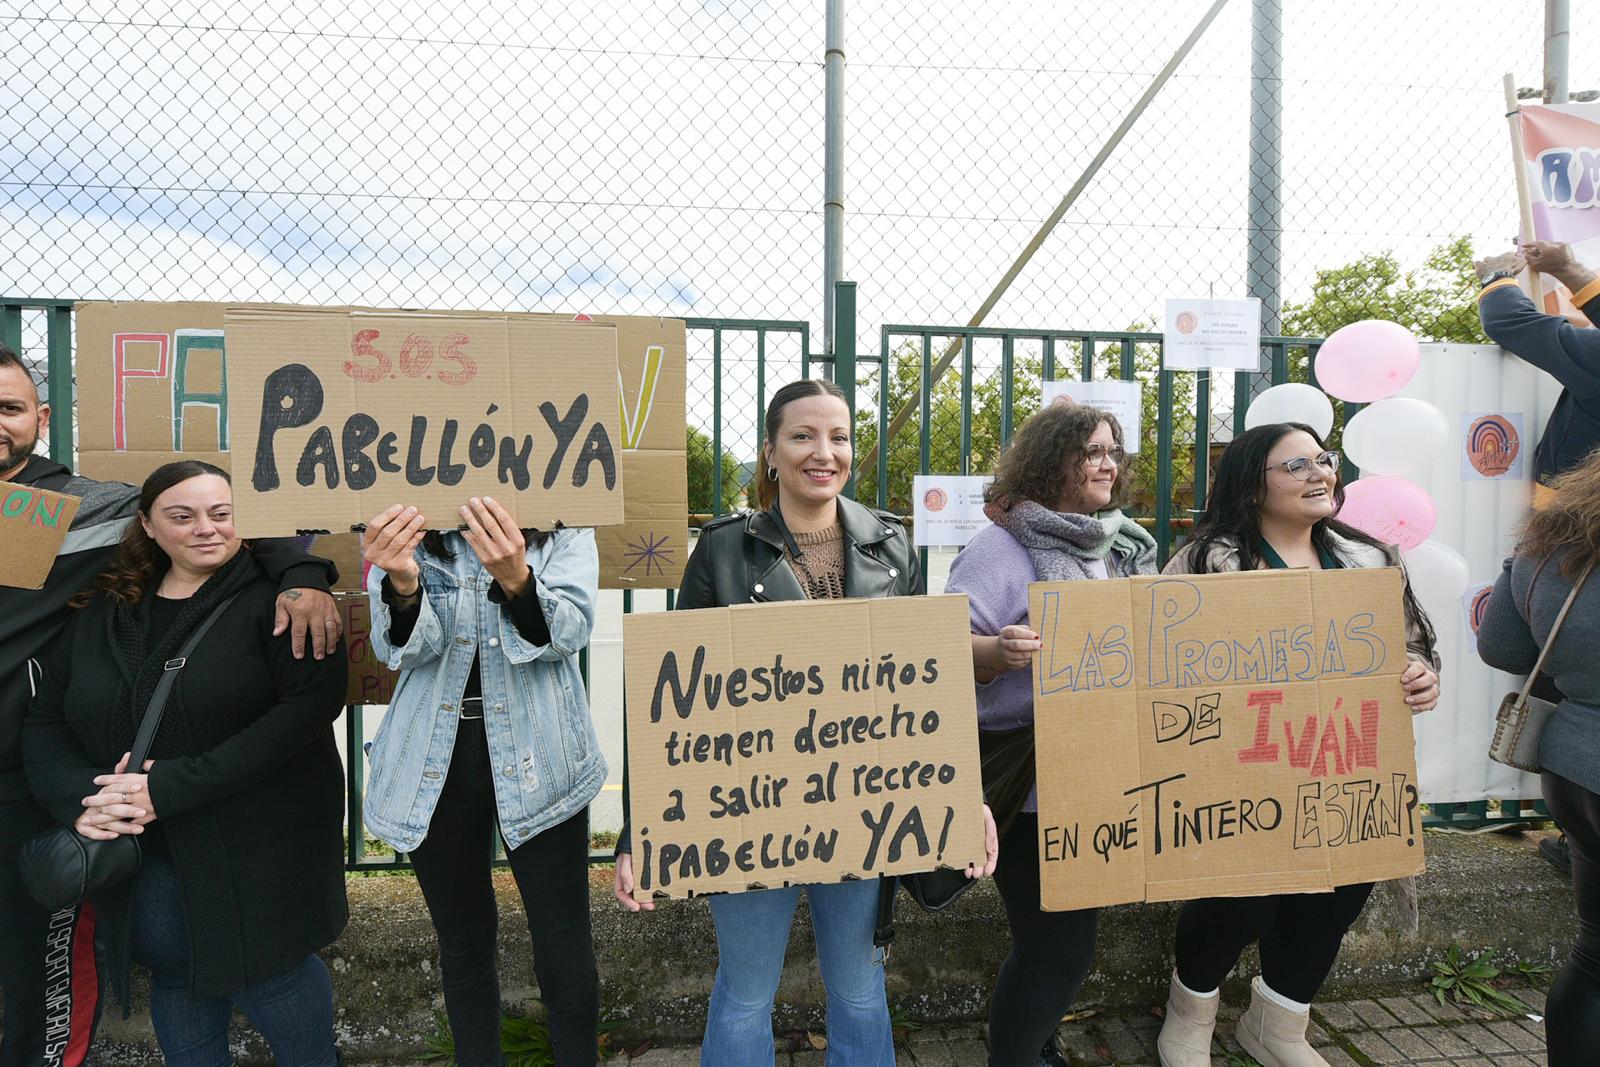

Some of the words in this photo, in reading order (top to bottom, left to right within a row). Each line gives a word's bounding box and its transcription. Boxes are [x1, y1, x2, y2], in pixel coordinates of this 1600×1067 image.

[538, 392, 616, 492] YA
[1040, 591, 1134, 695] LAS
[1146, 579, 1386, 689] PROMESAS
[650, 645, 825, 723] Nuestros
[842, 653, 939, 694] niños
[665, 726, 774, 766] tienen
[794, 703, 940, 755] derecho
[1152, 692, 1221, 745] DE
[1237, 689, 1380, 778] IVÁN
[663, 789, 686, 822] a
[709, 773, 789, 819] salir
[803, 761, 839, 804] al
[853, 760, 956, 797] recreo
[860, 801, 955, 872] YA!
[1044, 822, 1079, 861] EN
[1093, 803, 1139, 862] QUÉ
[45, 926, 72, 981] SPORT
